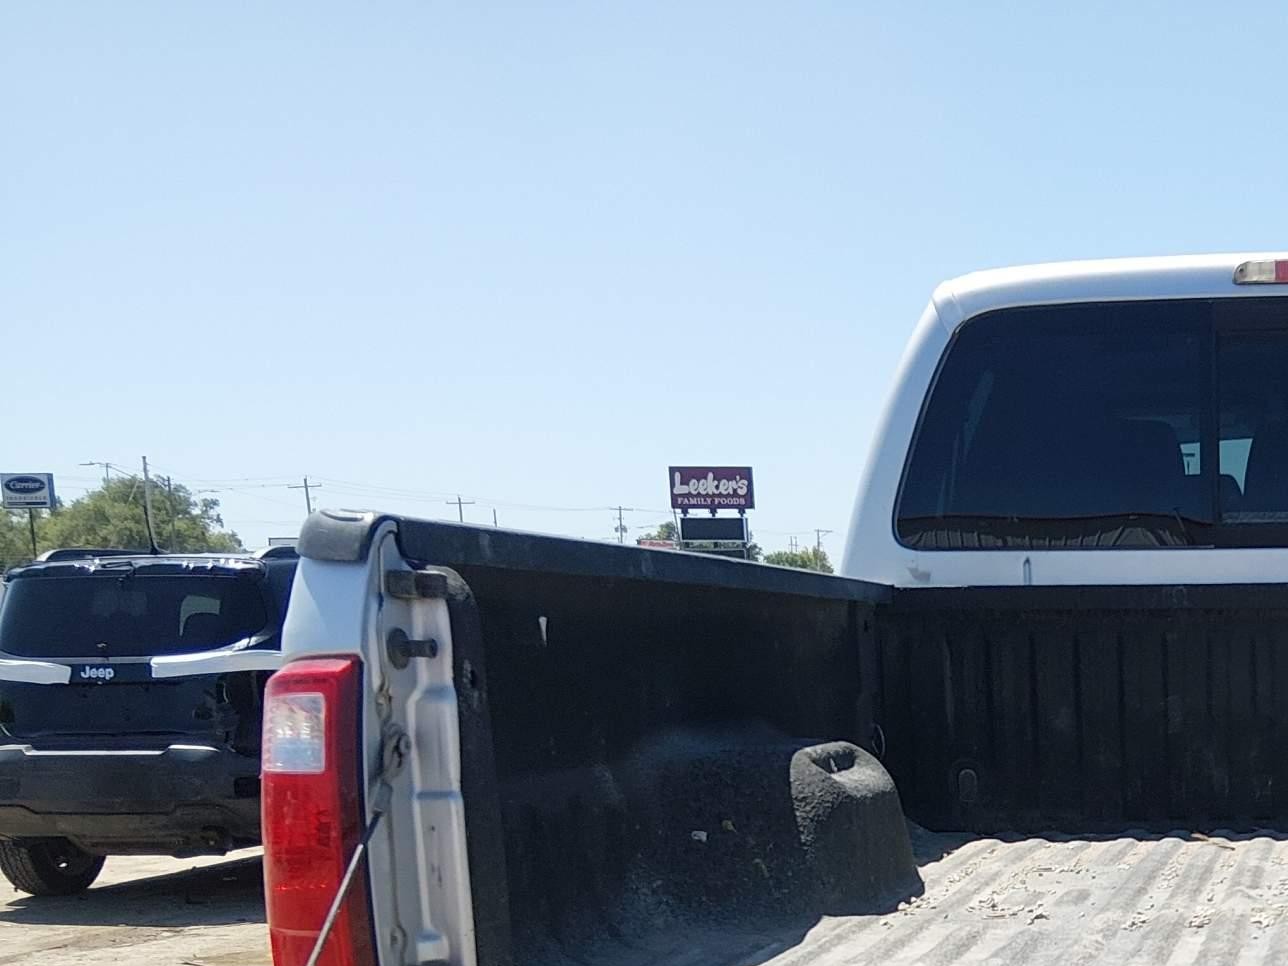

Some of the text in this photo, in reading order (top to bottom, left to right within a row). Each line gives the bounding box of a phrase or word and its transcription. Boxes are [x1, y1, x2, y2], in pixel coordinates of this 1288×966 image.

[673, 471, 748, 495] Leeker's
[678, 497, 745, 505] FAMILY FOODS
[80, 665, 114, 680] Jeep
